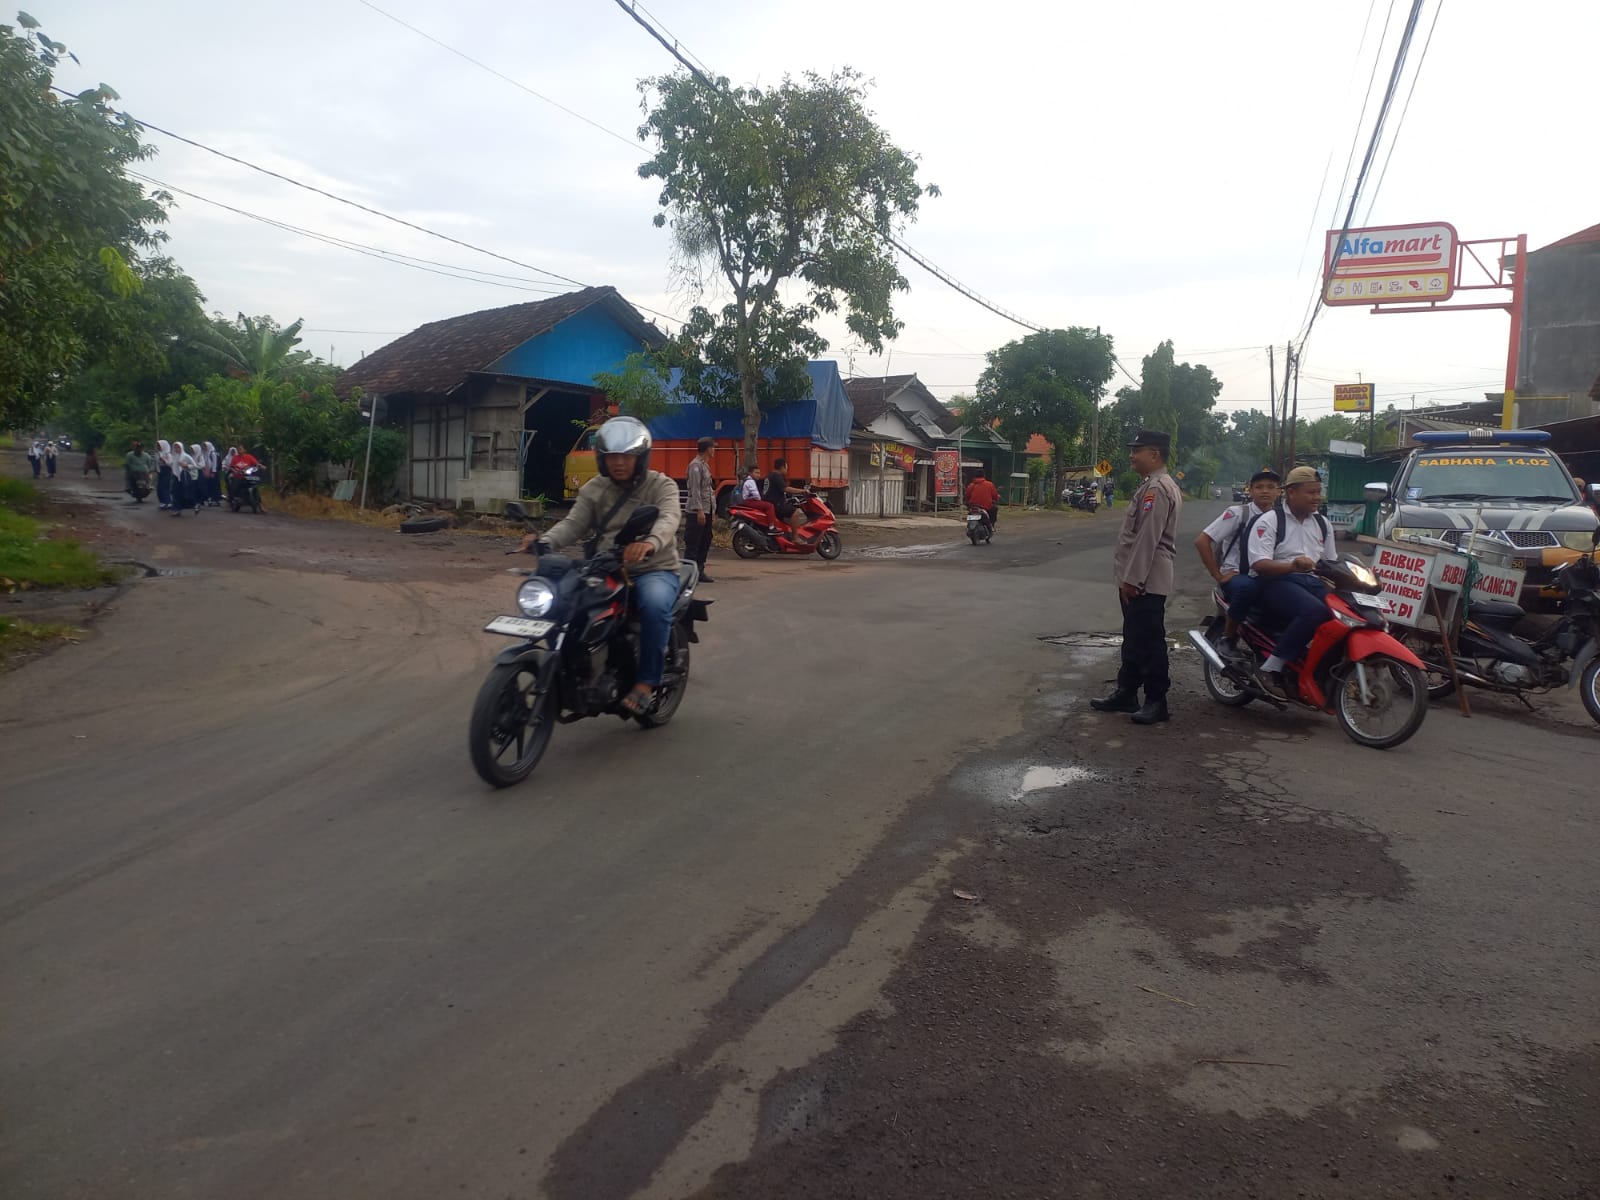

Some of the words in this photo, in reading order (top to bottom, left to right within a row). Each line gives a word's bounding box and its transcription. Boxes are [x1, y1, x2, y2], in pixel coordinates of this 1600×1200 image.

[1340, 234, 1442, 255] Alfamart
[1418, 458, 1496, 467] SABHARA
[1506, 458, 1550, 466] 14.02
[1379, 550, 1426, 574] BUBUR
[1441, 563, 1466, 585] BUBU
[1473, 575, 1504, 596] ACANG
